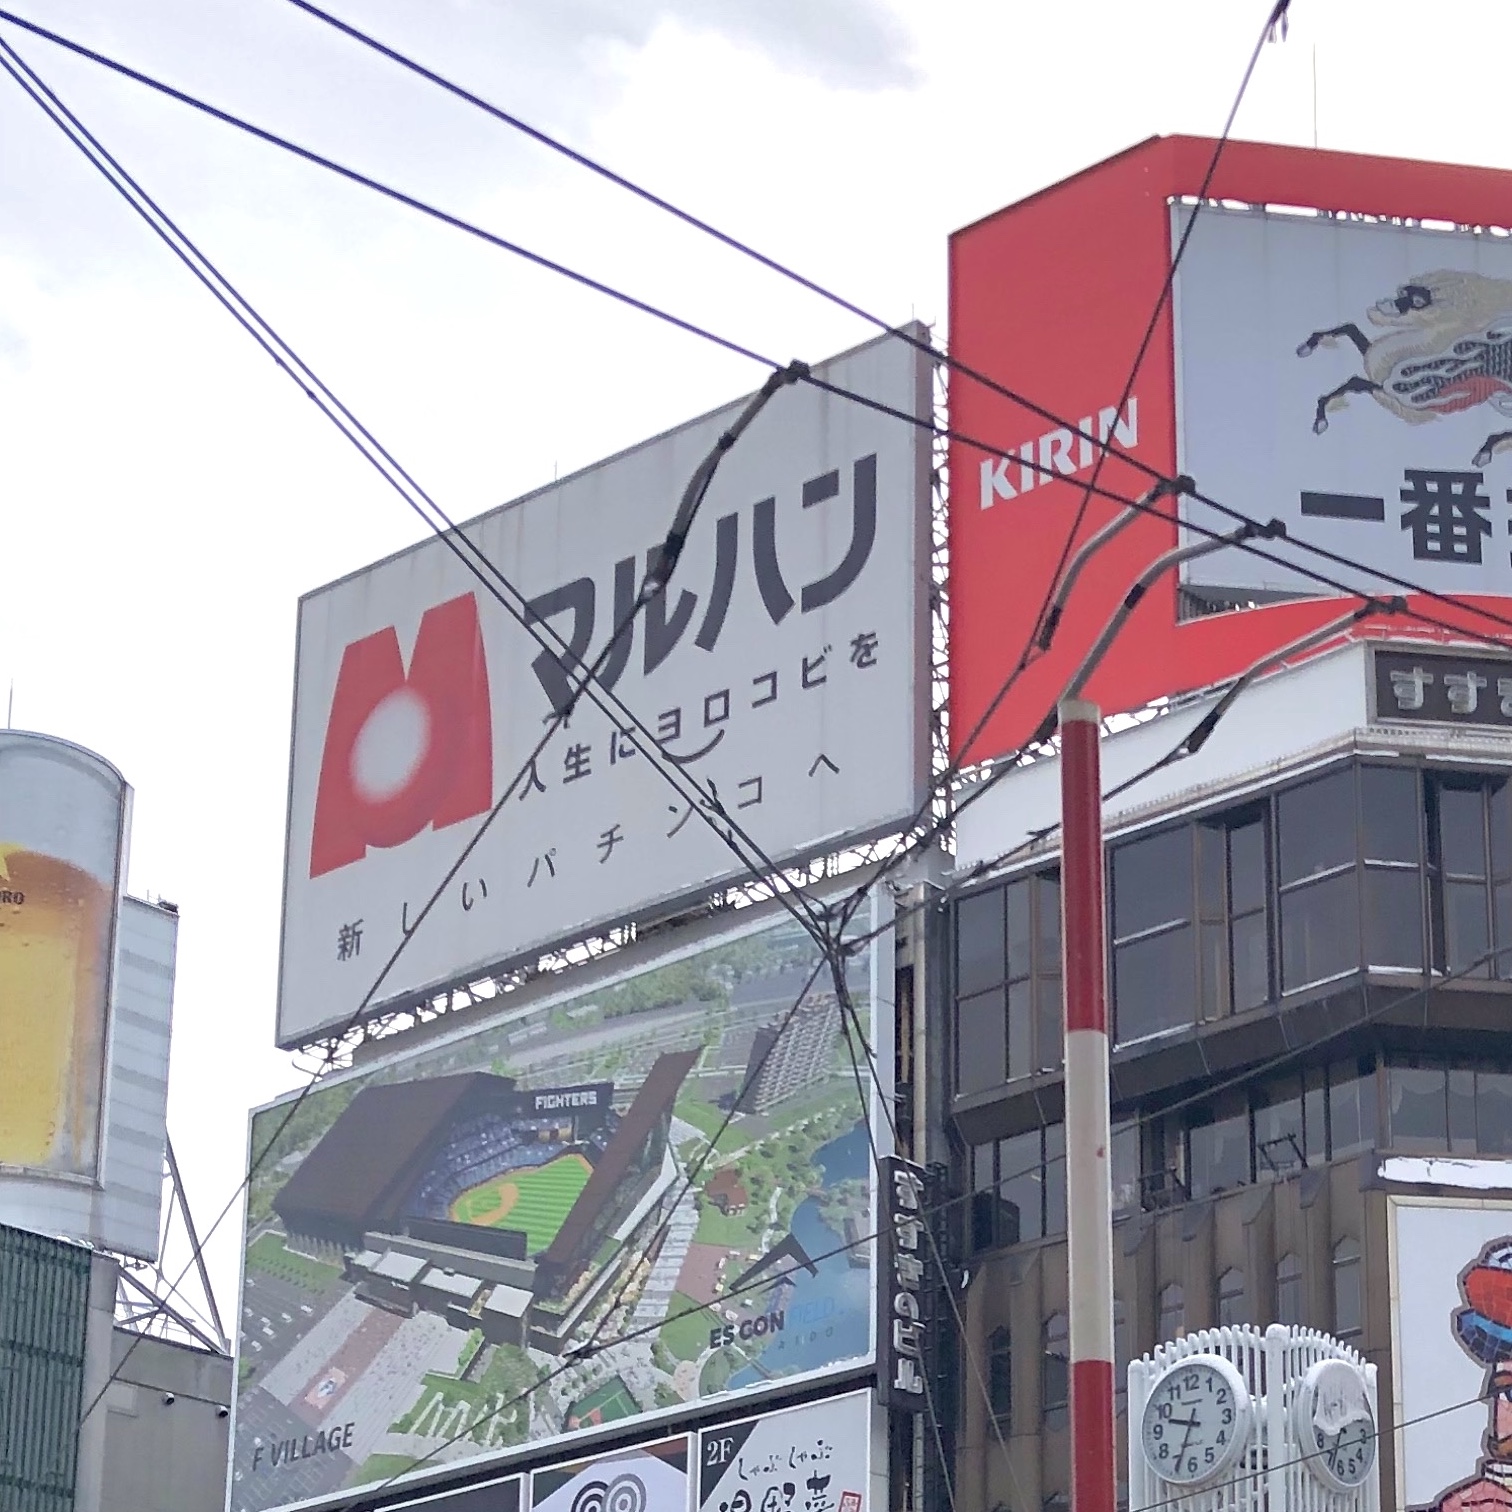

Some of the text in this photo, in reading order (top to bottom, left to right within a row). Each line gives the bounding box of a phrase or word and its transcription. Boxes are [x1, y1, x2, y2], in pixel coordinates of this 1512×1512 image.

[979, 396, 1139, 509] KIRIN
[523, 452, 878, 720] マルハン
[519, 632, 880, 800] 人生にヨロコビを
[336, 753, 841, 962] 新しいパチンコへ
[534, 1089, 598, 1111] FIGHTERS
[893, 1170, 925, 1395] すすきのビル
[709, 1310, 785, 1349] ESCON
[1183, 1373, 1200, 1391] 12
[1205, 1376, 1213, 1393] 1
[1168, 1384, 1182, 1400] 11
[1216, 1388, 1227, 1405] 2
[1156, 1402, 1173, 1418] 10
[1221, 1408, 1232, 1425] 3
[1153, 1424, 1164, 1440] 9
[1215, 1430, 1227, 1446] 4
[252, 1423, 356, 1472] F VILLAGE
[707, 1437, 735, 1467] 2F
[1158, 1443, 1169, 1459] 8
[1204, 1446, 1215, 1463] 5
[1173, 1454, 1184, 1473] 7
[1187, 1456, 1198, 1473] 6
